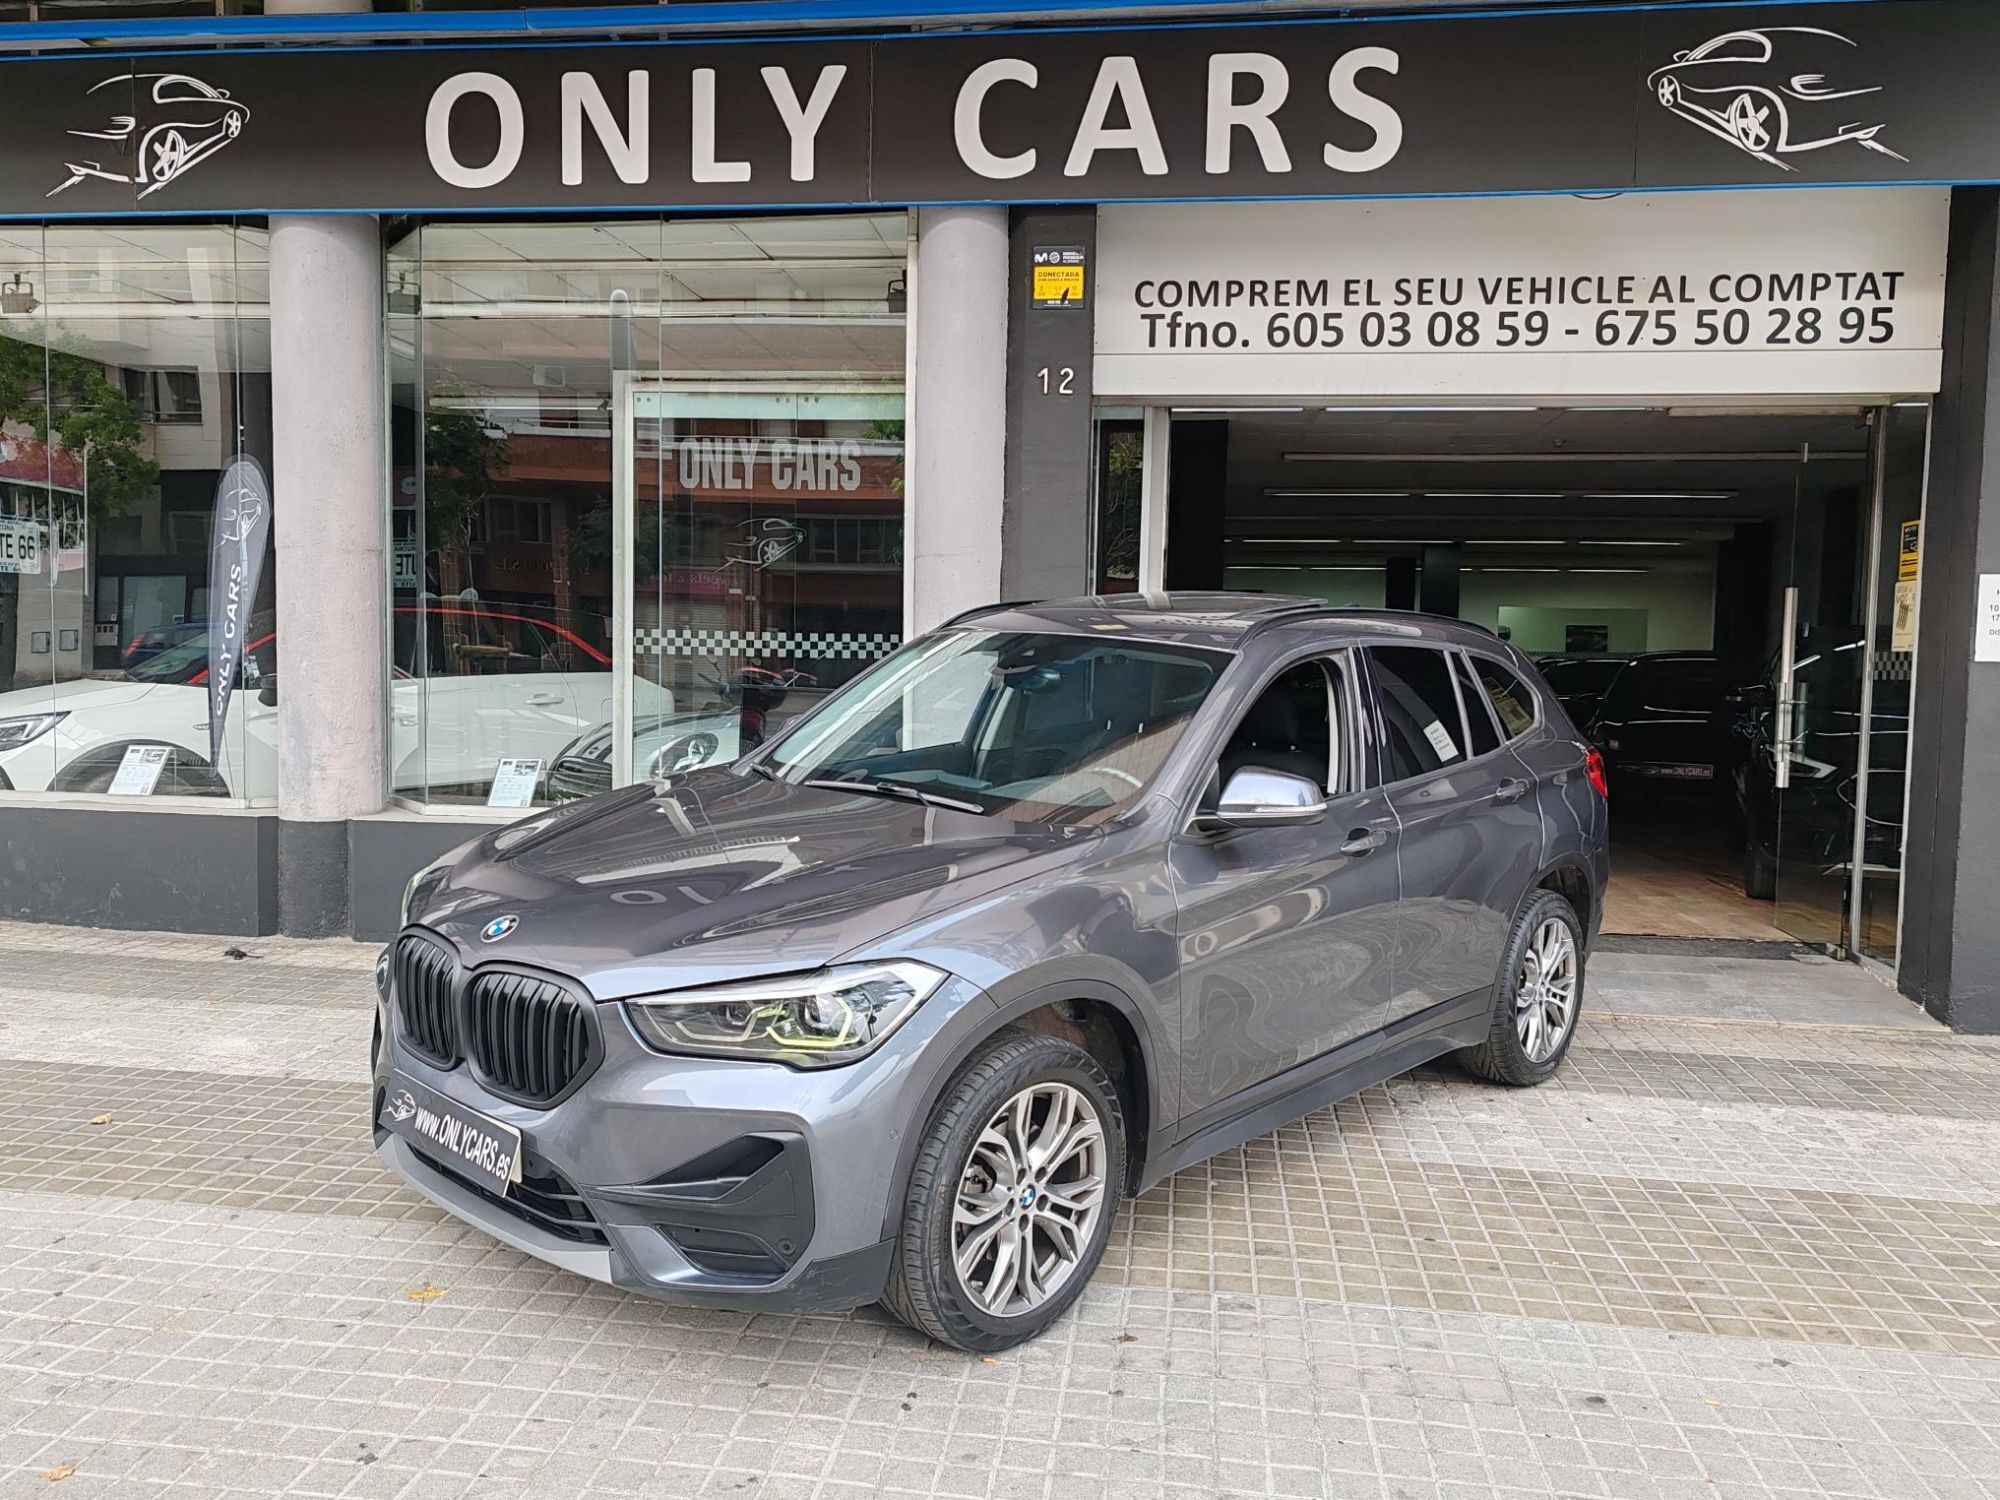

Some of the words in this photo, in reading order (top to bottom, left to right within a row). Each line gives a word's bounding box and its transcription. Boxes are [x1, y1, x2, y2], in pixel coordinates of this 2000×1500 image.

[425, 65, 848, 188] ONLY
[954, 46, 1403, 179] CARS
[1134, 279, 1328, 307] COMPREM
[1343, 278, 1382, 307] EL
[1393, 277, 1464, 306] SEU
[1478, 275, 1635, 305] VEHICLE
[1647, 274, 1696, 304] AL
[1708, 271, 1905, 303] COMPTAT
[1140, 310, 1250, 348] Tfno.
[1266, 311, 1345, 348] 605
[1359, 311, 1412, 347] 03
[1427, 310, 1481, 347] 08
[1495, 310, 1549, 347] 59
[1564, 328, 1580, 336] -
[1594, 308, 1677, 346] 675
[1693, 307, 1750, 345] 50
[1765, 306, 1822, 345] 28
[1838, 305, 1894, 344] 95
[1037, 367, 1075, 395] 12
[679, 437, 761, 490] ONLY
[771, 439, 861, 491] CARS
[18, 534, 36, 560] 66
[216, 643, 232, 716] ONLY
[224, 564, 242, 639] CARS
[414, 1106, 511, 1180] www.ONLYCARS.es
